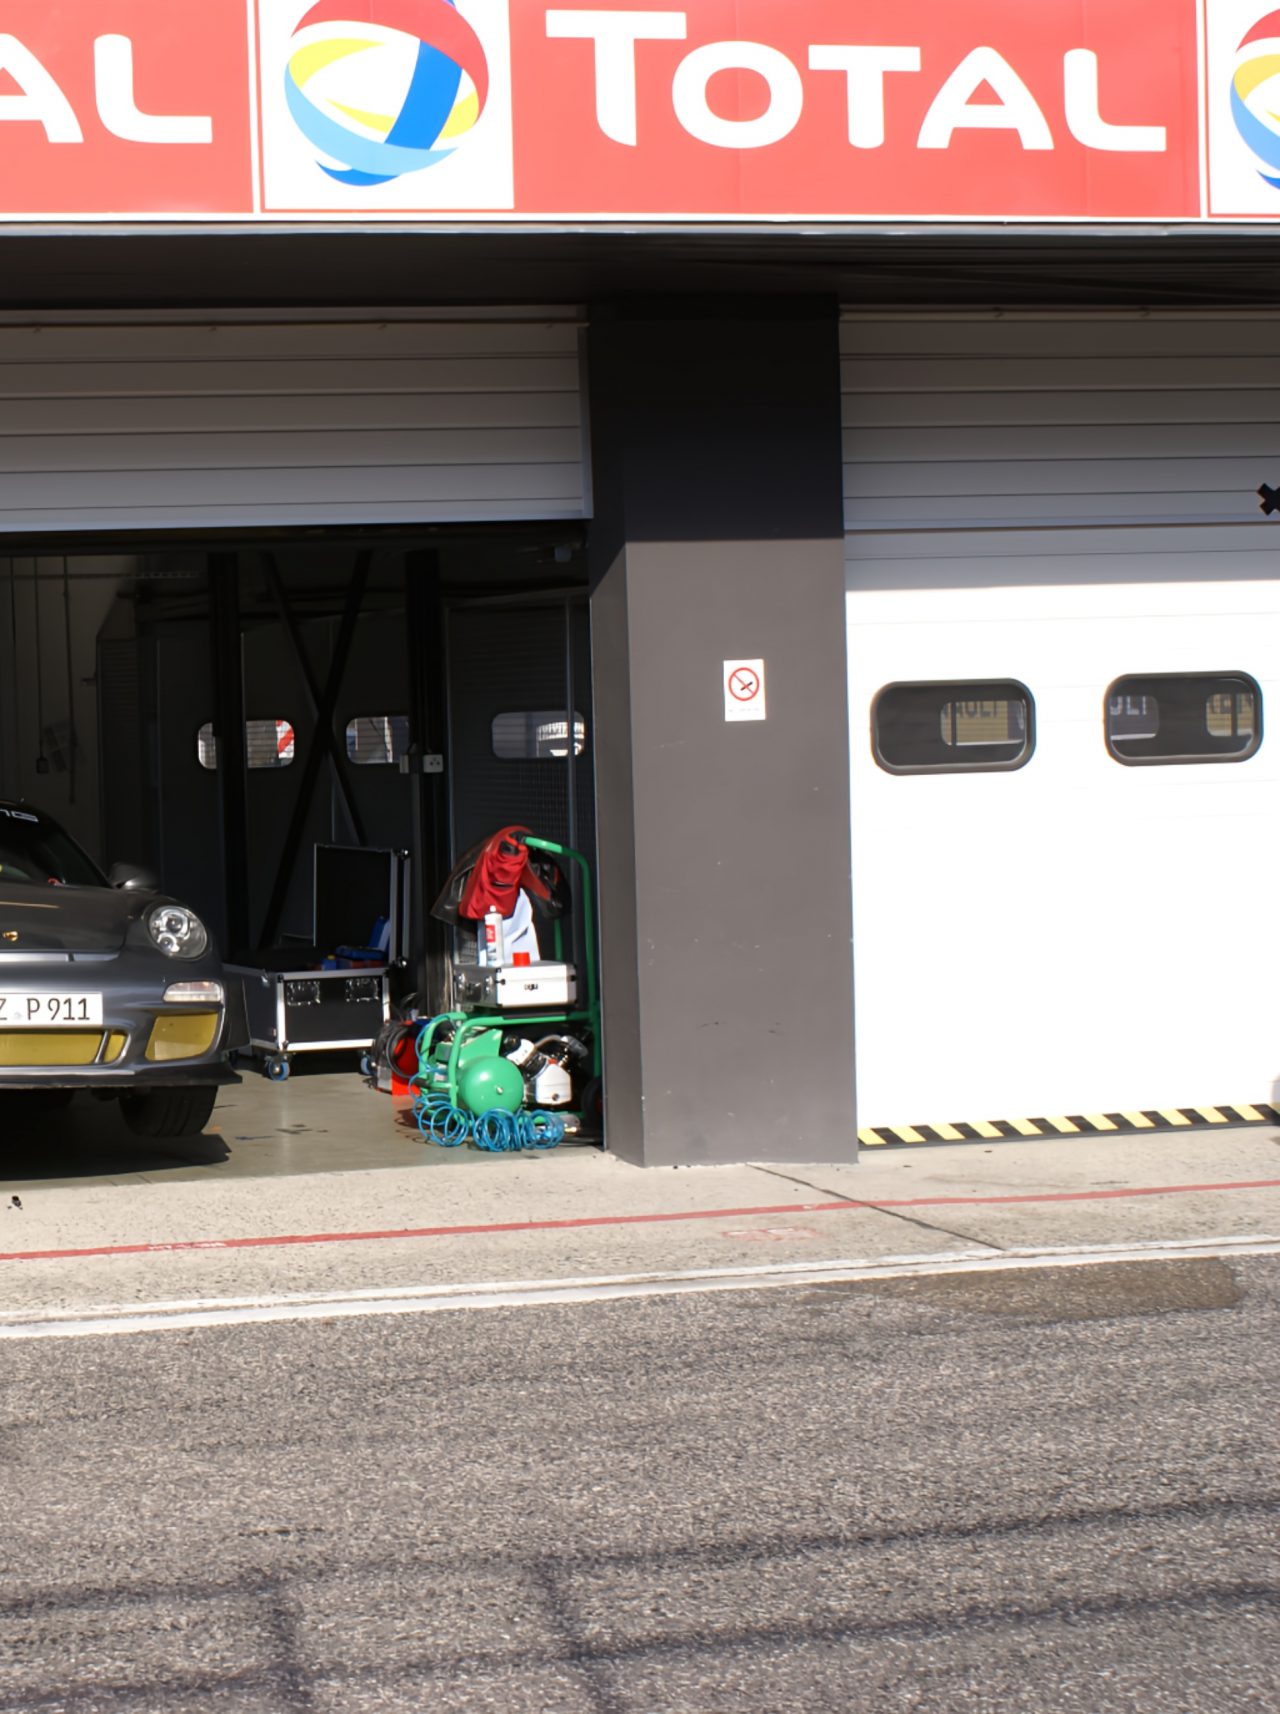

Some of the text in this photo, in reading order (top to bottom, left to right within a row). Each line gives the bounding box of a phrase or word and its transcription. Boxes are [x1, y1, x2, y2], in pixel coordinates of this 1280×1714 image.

[545, 9, 1168, 153] TOTAL
[26, 998, 41, 1020] P
[47, 998, 90, 1021] 911
